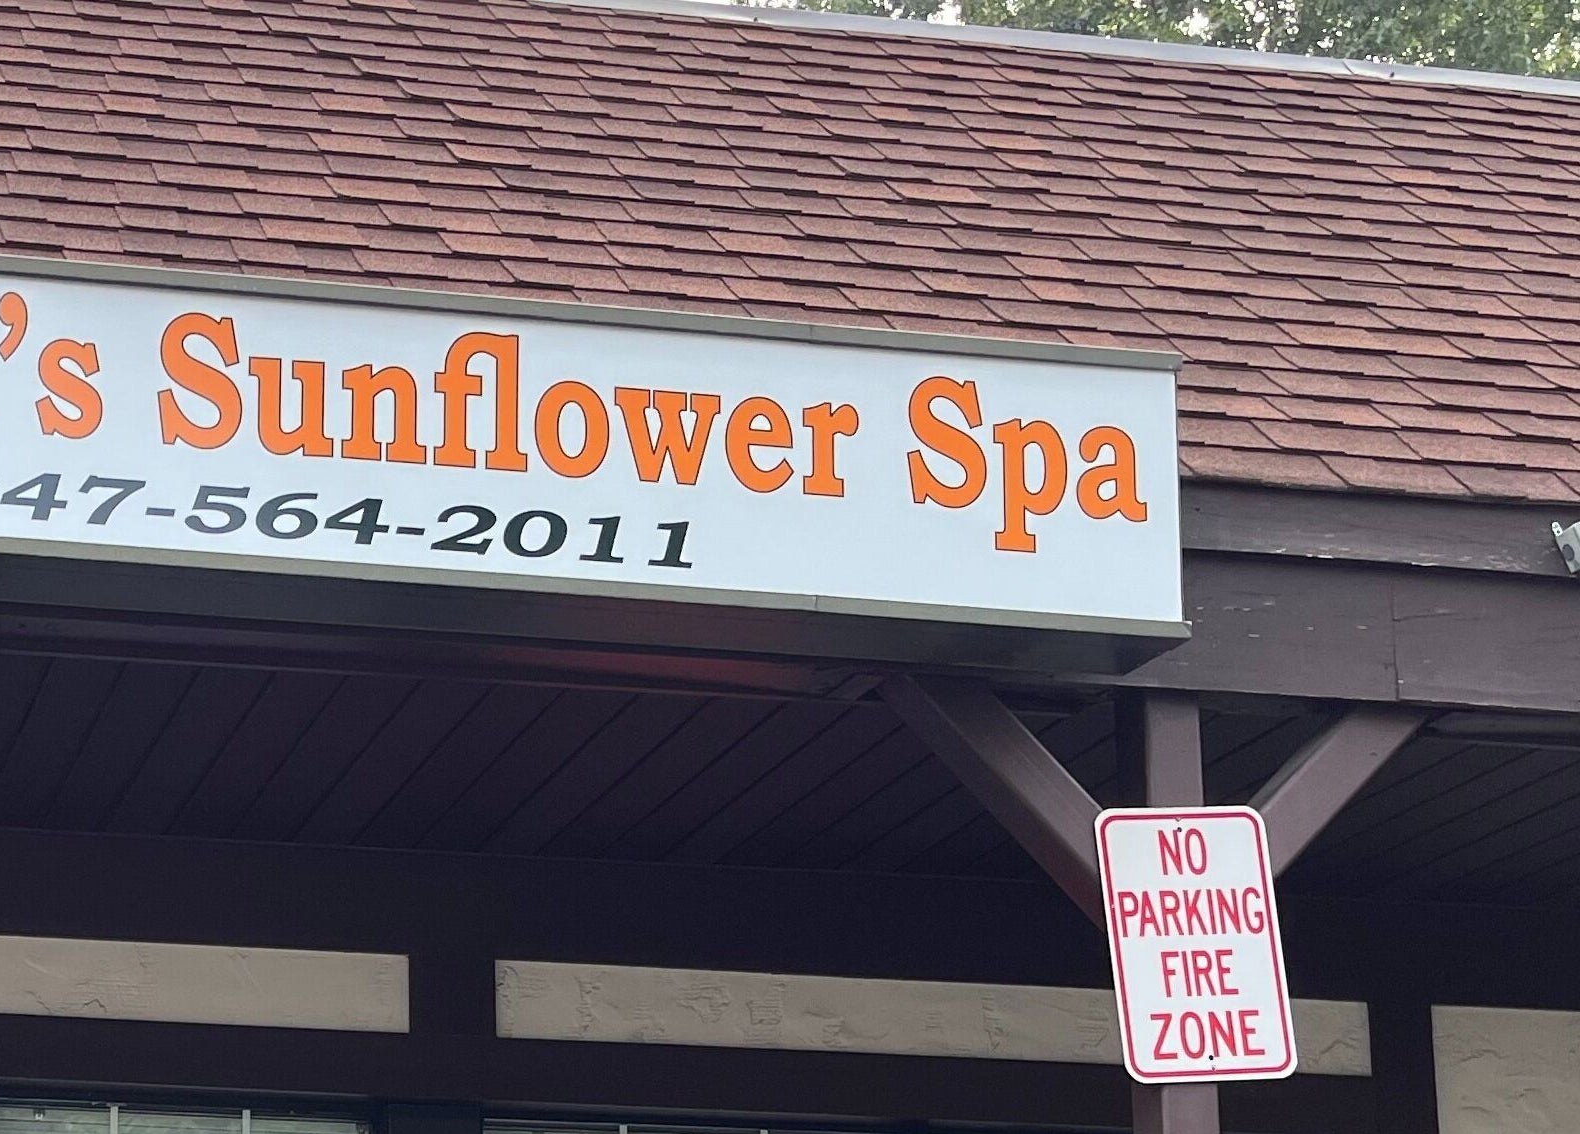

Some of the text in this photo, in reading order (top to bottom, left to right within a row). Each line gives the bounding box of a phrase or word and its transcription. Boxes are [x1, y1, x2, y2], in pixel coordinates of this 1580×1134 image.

[158, 311, 859, 497] Sunflower
[907, 375, 1149, 553] Spa
[1157, 828, 1207, 876] NO
[1117, 887, 1265, 937] PARKING
[1160, 949, 1239, 998] FIRE
[1150, 1010, 1265, 1060] ZONE
